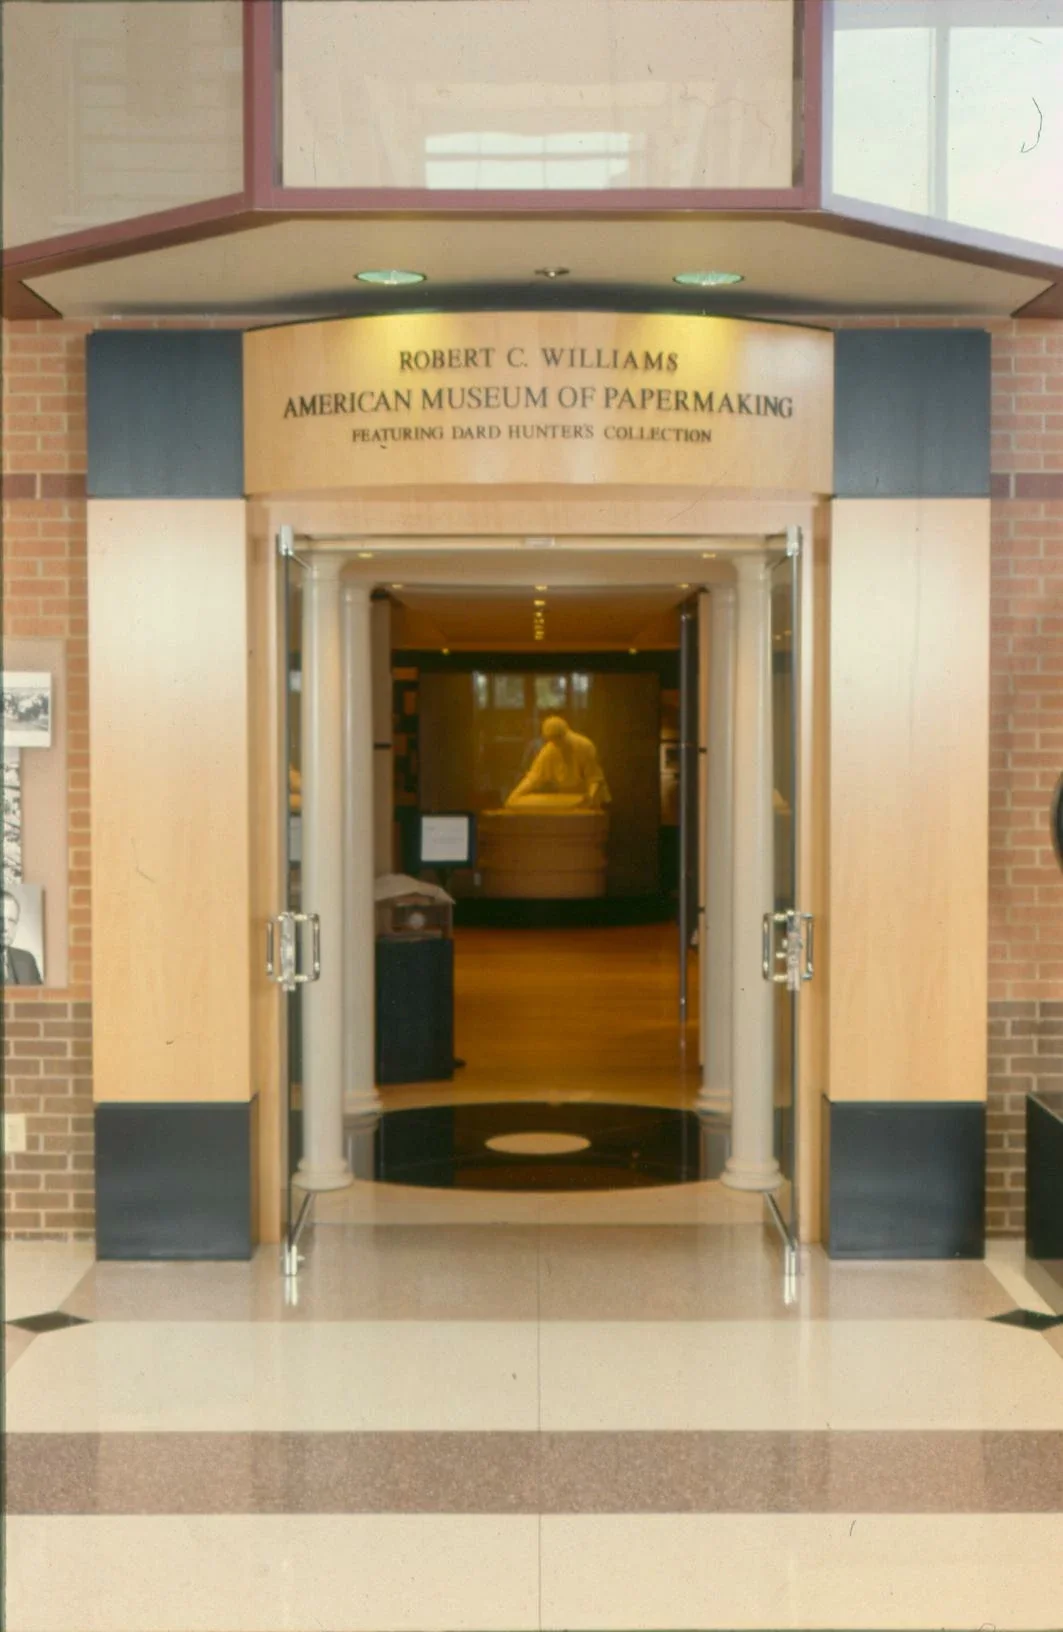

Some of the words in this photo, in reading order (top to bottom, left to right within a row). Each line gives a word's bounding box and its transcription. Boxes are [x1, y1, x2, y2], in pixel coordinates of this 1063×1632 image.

[399, 348, 495, 371] ROBERT
[507, 347, 529, 369] C.
[542, 348, 679, 372] WILLIAMS
[283, 388, 411, 419] AMERICAN
[422, 387, 549, 410] MUSEUM
[558, 387, 596, 409] OF
[604, 388, 794, 419] PAPERMAKING
[352, 425, 444, 443] FEATURING
[452, 425, 501, 441] DARD
[508, 424, 595, 440] HUNTER'S
[604, 425, 713, 443] COLLECTION
